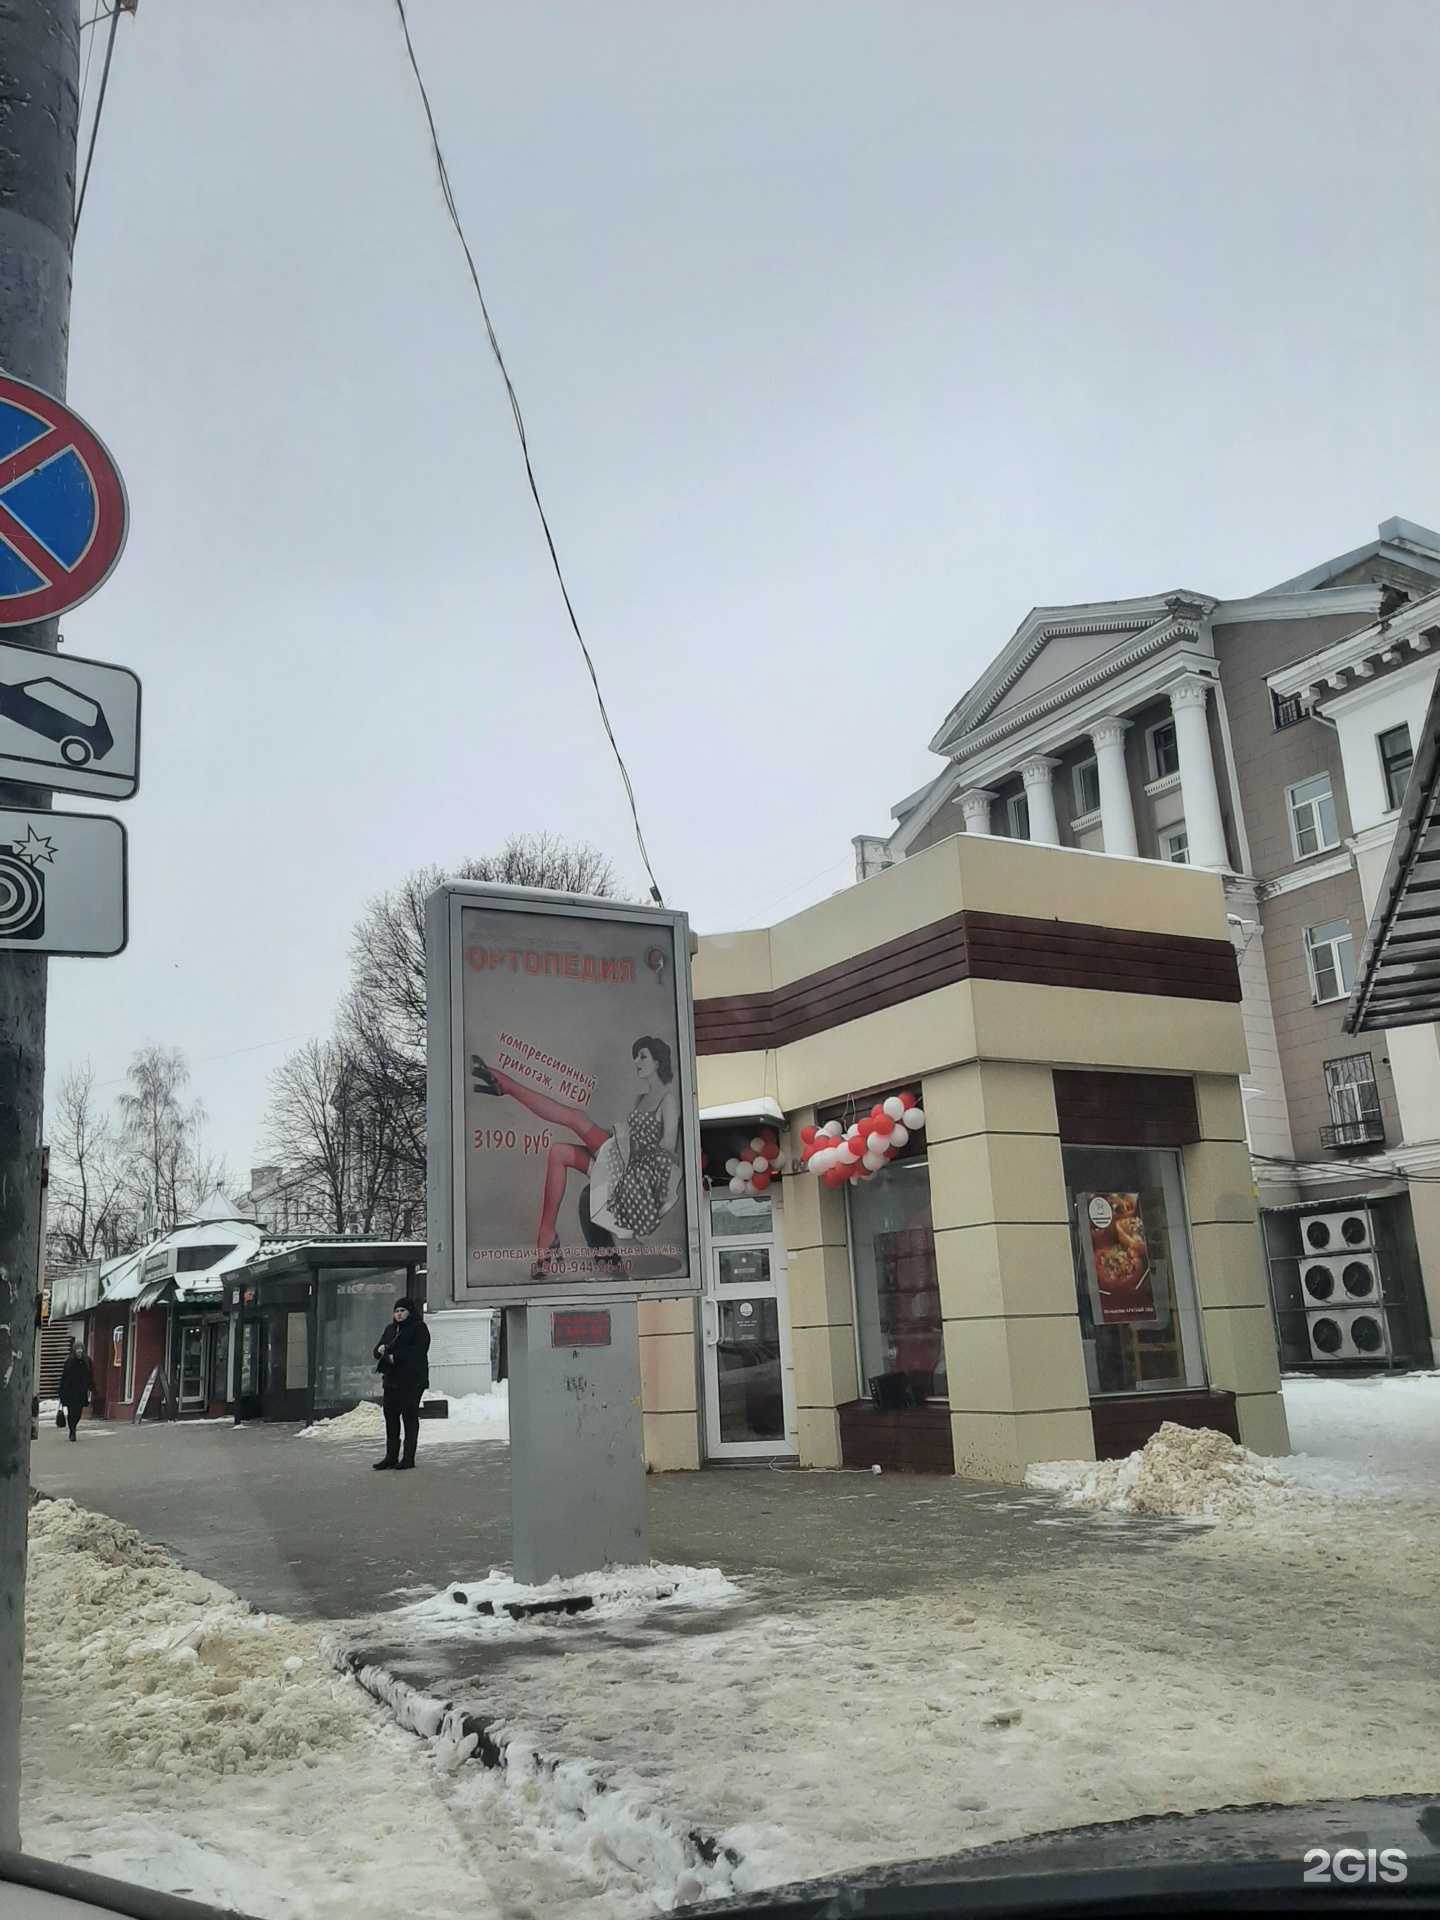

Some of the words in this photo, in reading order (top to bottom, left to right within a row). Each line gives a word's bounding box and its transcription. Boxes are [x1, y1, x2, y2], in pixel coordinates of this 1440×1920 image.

[466, 945, 636, 984] ОРТОПЕДИЯ
[499, 1052, 553, 1089] трикотаж,
[559, 1079, 592, 1105] MEDI
[500, 1032, 596, 1089] компрессионный
[473, 1129, 516, 1149] 3190
